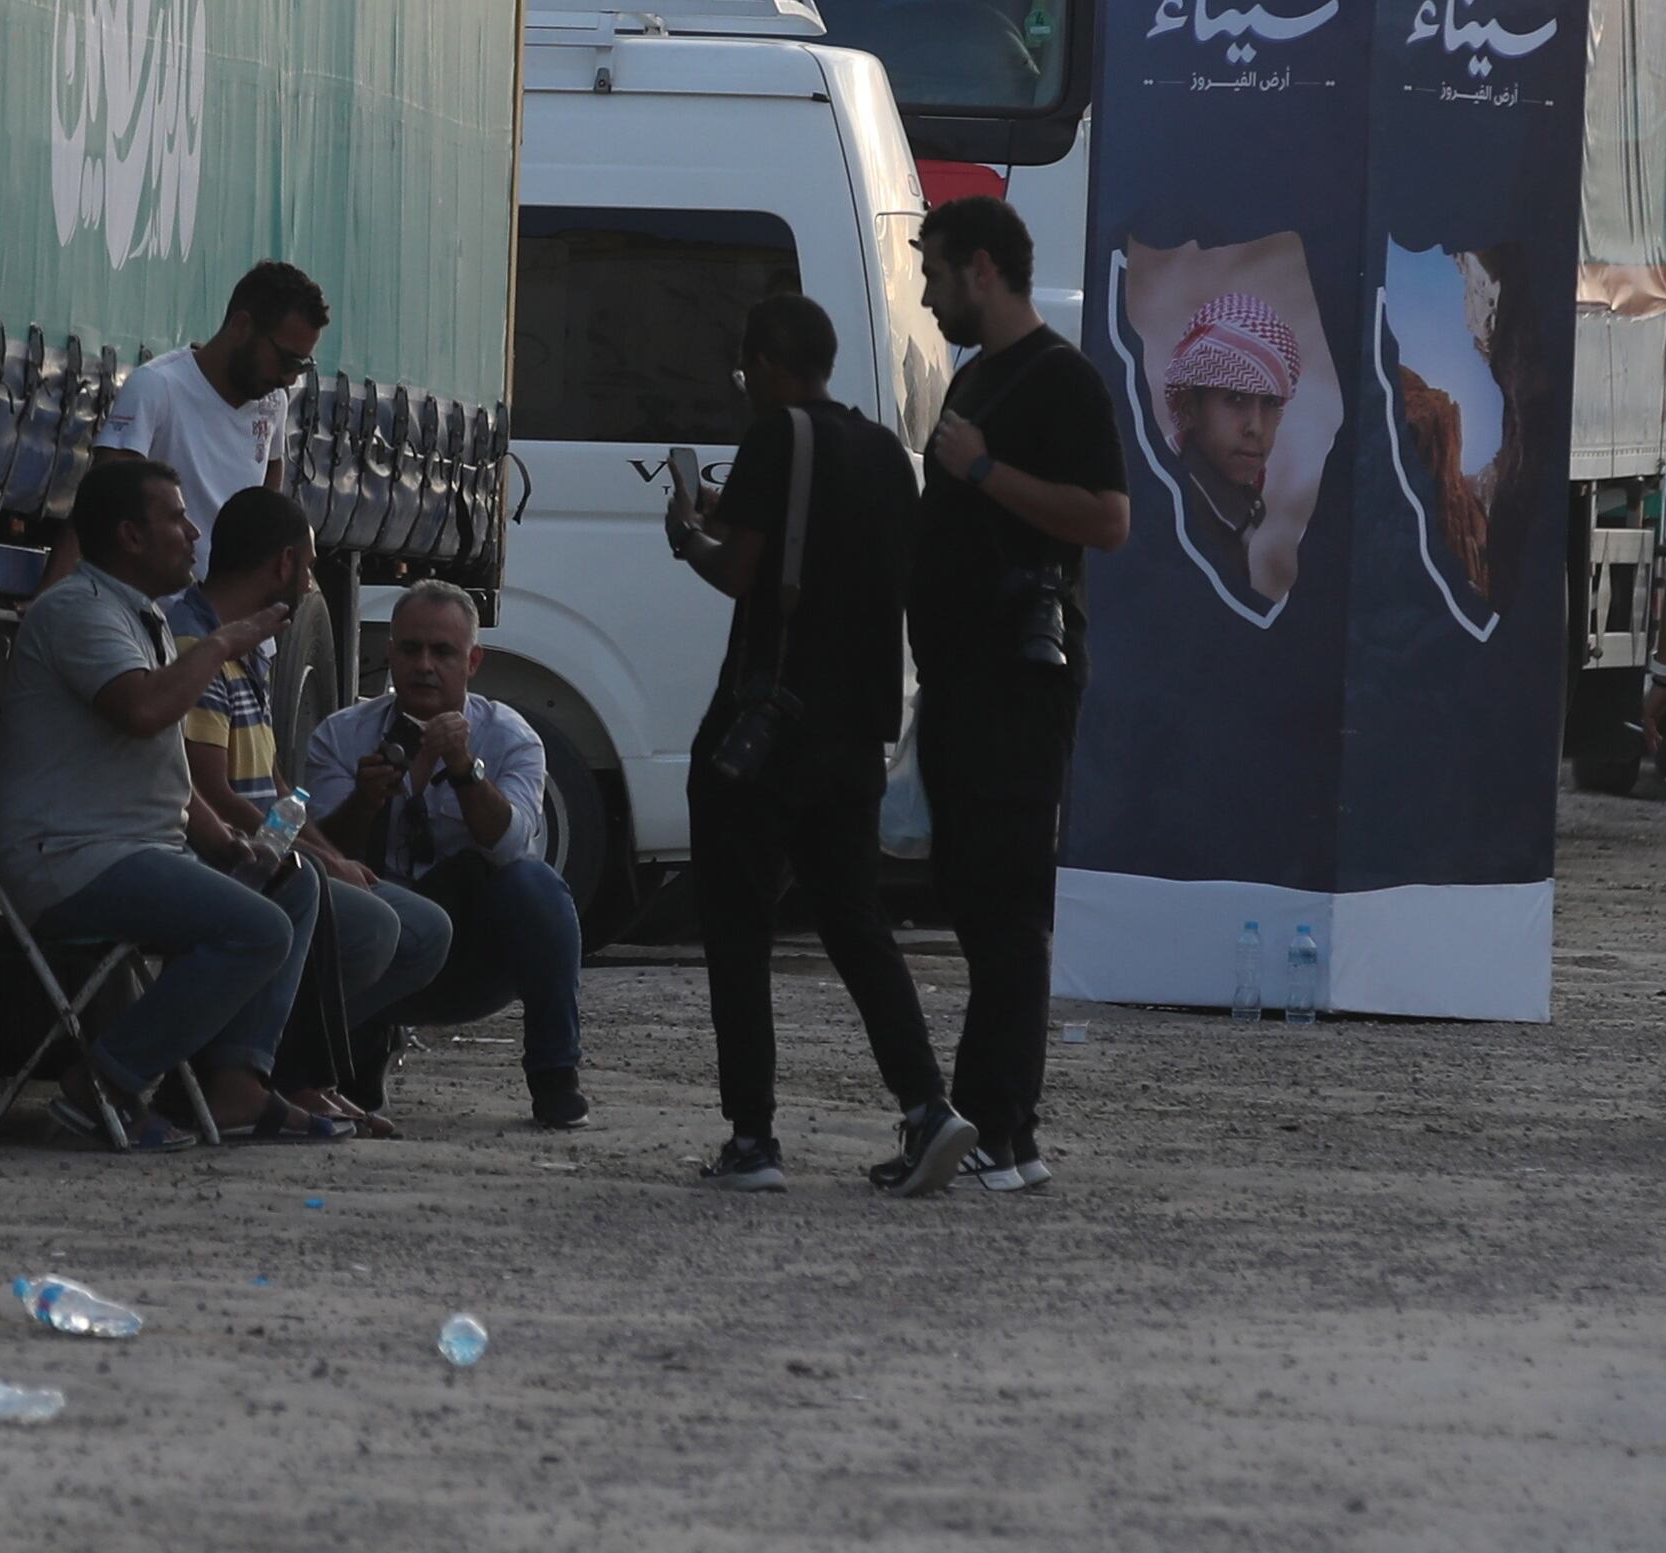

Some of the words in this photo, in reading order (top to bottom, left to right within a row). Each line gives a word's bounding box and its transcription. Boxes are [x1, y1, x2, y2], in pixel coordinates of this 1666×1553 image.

[1189, 71, 1257, 91] الفيروز
[1258, 65, 1291, 91] أرض
[1439, 80, 1493, 106] الفيروز
[1493, 82, 1519, 108] أرض
